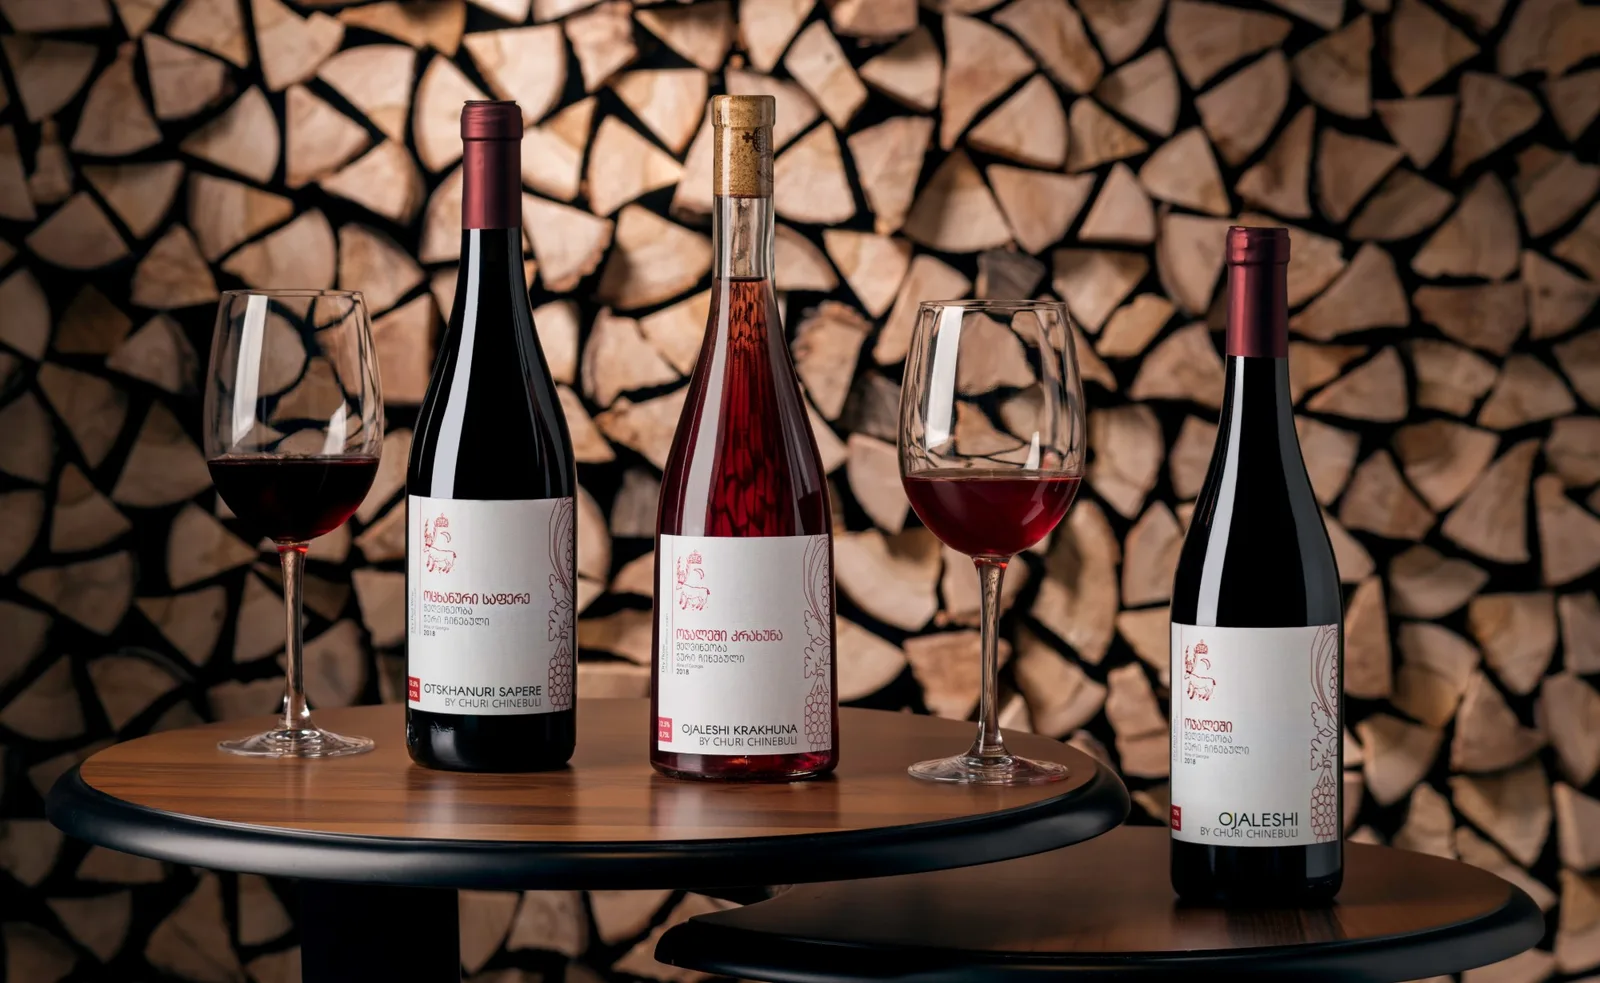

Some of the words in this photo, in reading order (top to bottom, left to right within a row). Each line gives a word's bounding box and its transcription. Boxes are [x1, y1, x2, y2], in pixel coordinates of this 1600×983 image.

[424, 590, 478, 604] ოცხანური
[482, 592, 530, 605] საფერე
[676, 628, 727, 642] ოჯალეში
[731, 630, 783, 642] კრახუნა
[424, 683, 495, 697] OTSKHANURI
[499, 685, 542, 696] SAPERE
[445, 698, 455, 706] BY
[458, 698, 489, 708] CHURI
[492, 698, 541, 708] CHINEBULI
[682, 724, 729, 736] OJALESHI
[734, 724, 798, 735] KRAKHUNA
[1185, 718, 1233, 733] ოჯალეში
[700, 737, 710, 746] BY
[713, 738, 743, 746] CHURI
[747, 736, 797, 746] CHINEBULI
[1219, 812, 1298, 830] OJALESHI
[1200, 827, 1210, 836] BY
[1213, 828, 1242, 838] CHURI
[1246, 829, 1298, 838] CHINEBULI
